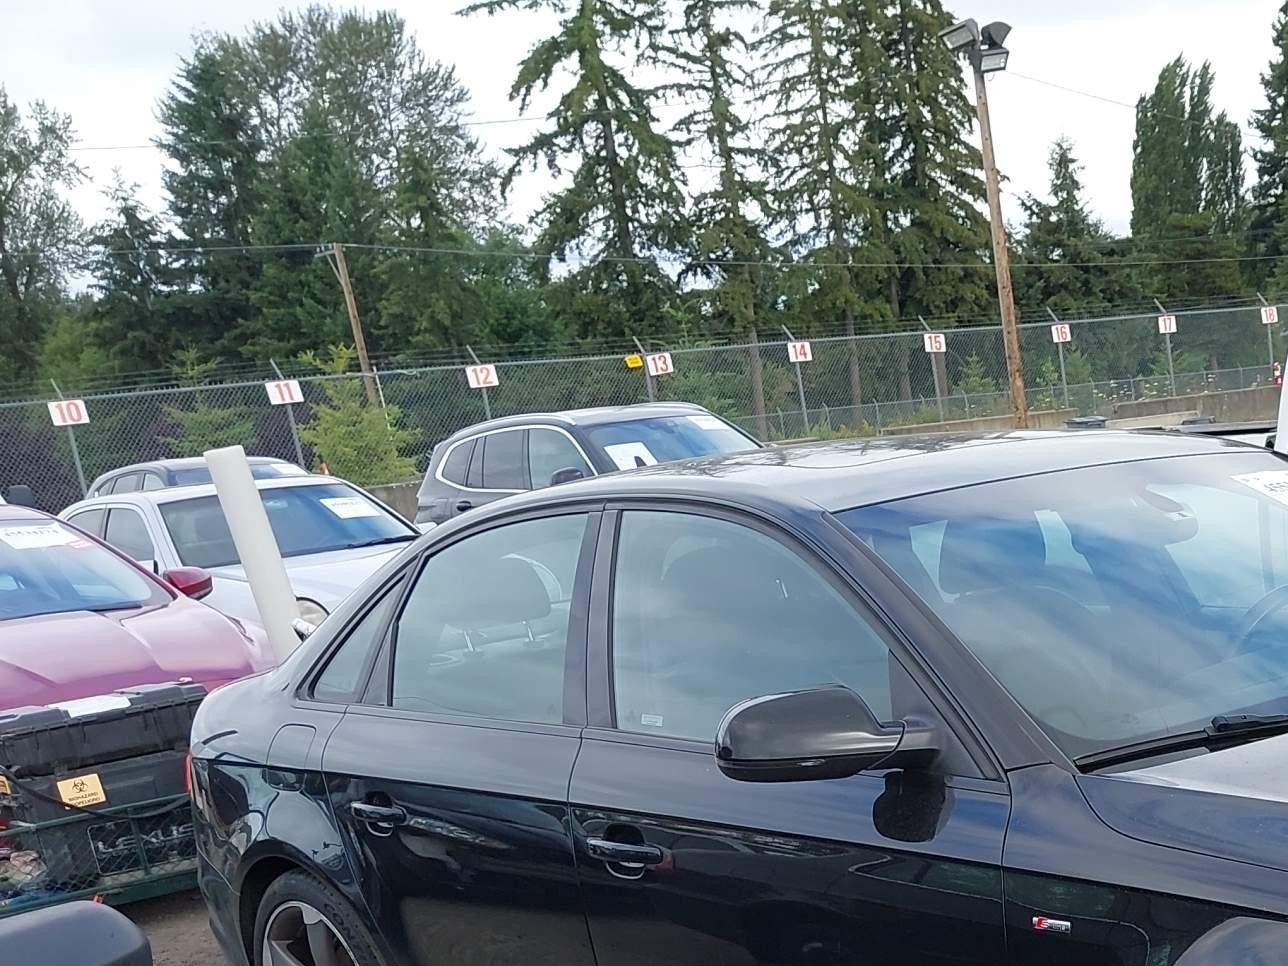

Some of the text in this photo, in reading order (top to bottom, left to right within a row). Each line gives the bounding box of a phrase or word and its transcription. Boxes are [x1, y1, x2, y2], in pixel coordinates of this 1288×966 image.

[1264, 308, 1275, 322] 18
[1163, 317, 1172, 331] 17
[1056, 325, 1067, 341] 16
[792, 343, 807, 360] 14
[928, 335, 942, 351] 15
[652, 355, 669, 373] 13
[472, 366, 494, 386] 12
[274, 382, 294, 402] 11
[55, 402, 82, 424] 10
[97, 822, 195, 853] LEXUS
